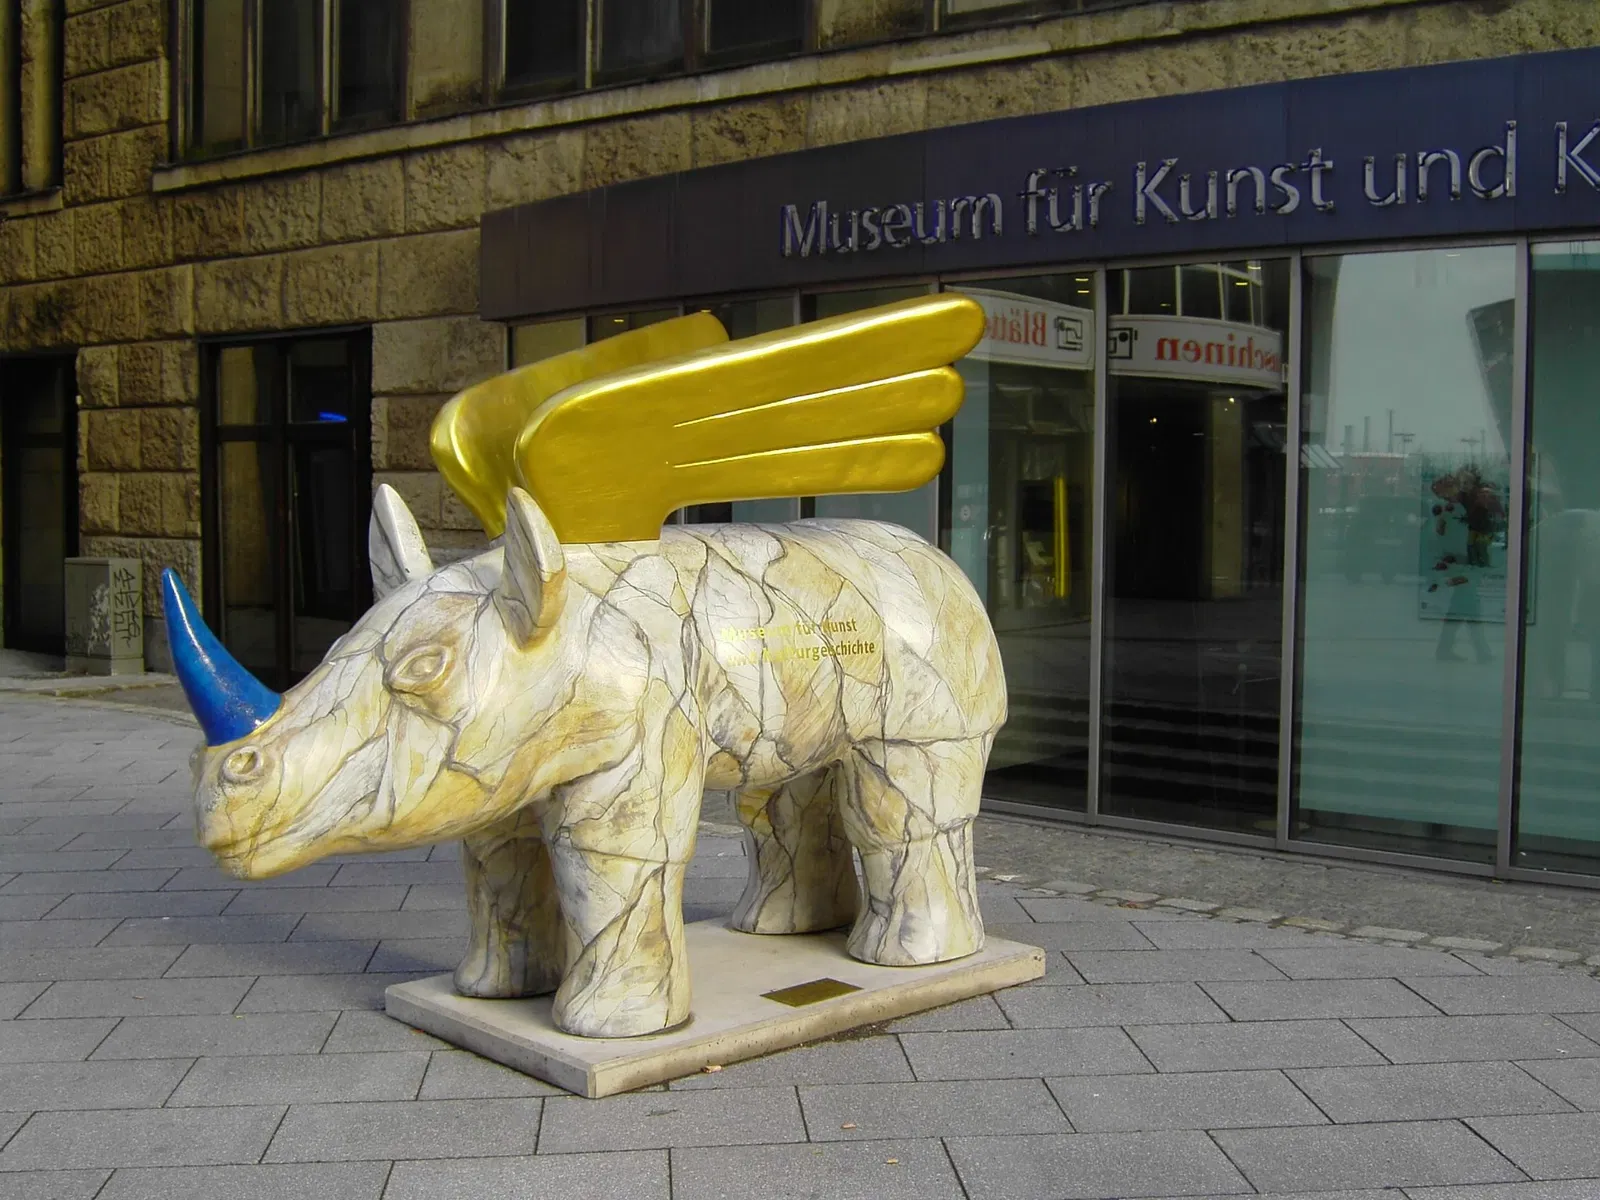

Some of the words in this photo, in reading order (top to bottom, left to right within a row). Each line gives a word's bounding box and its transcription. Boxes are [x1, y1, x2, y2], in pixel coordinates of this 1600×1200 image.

[780, 192, 1003, 257] Museum
[1016, 165, 1113, 236] für
[1134, 147, 1334, 225] Kunst
[1363, 120, 1517, 205] und
